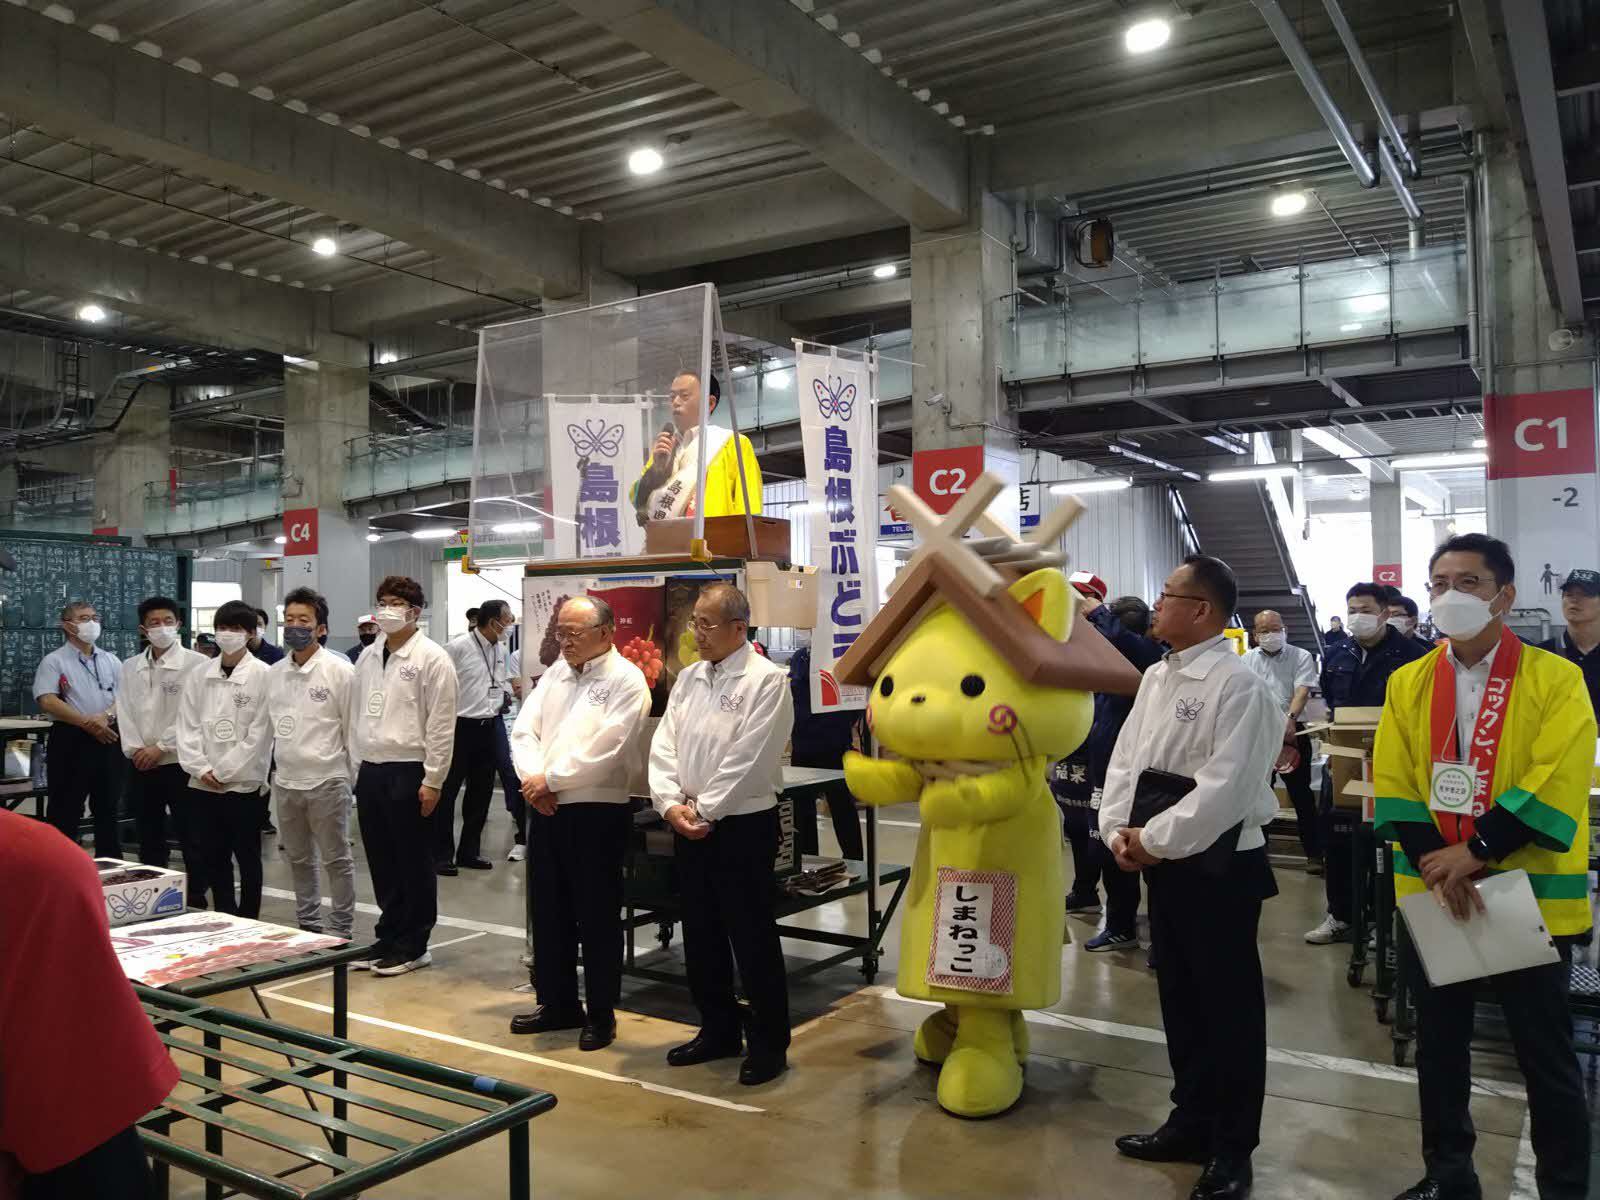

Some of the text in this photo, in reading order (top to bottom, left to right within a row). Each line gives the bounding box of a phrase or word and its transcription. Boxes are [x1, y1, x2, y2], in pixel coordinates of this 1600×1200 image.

[1514, 416, 1567, 452] C1
[929, 467, 967, 496] C2
[580, 462, 622, 557] 島根
[1552, 486, 1579, 508] -2
[291, 523, 310, 542] C4
[1378, 571, 1397, 582] C2
[948, 885, 979, 973] しまねっこ
